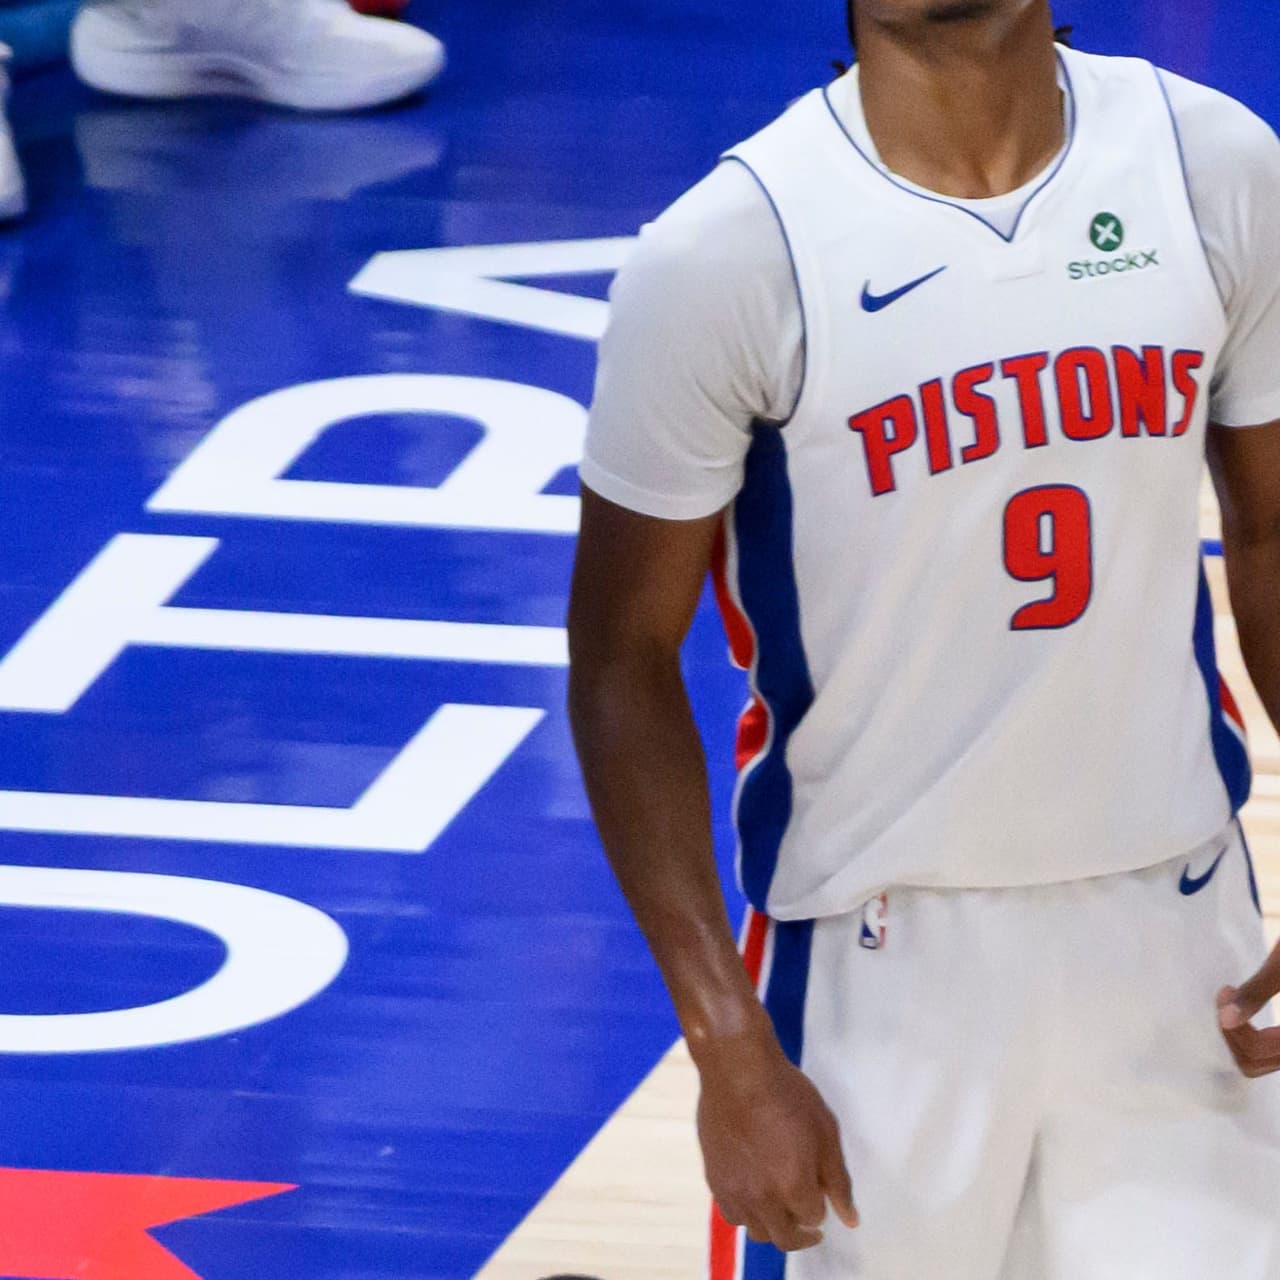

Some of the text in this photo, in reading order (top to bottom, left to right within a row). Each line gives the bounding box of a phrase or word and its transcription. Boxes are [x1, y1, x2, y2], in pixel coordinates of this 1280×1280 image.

[1066, 248, 1160, 281] StockX
[847, 344, 1205, 498] PISTONS
[1002, 482, 1094, 632] 9
